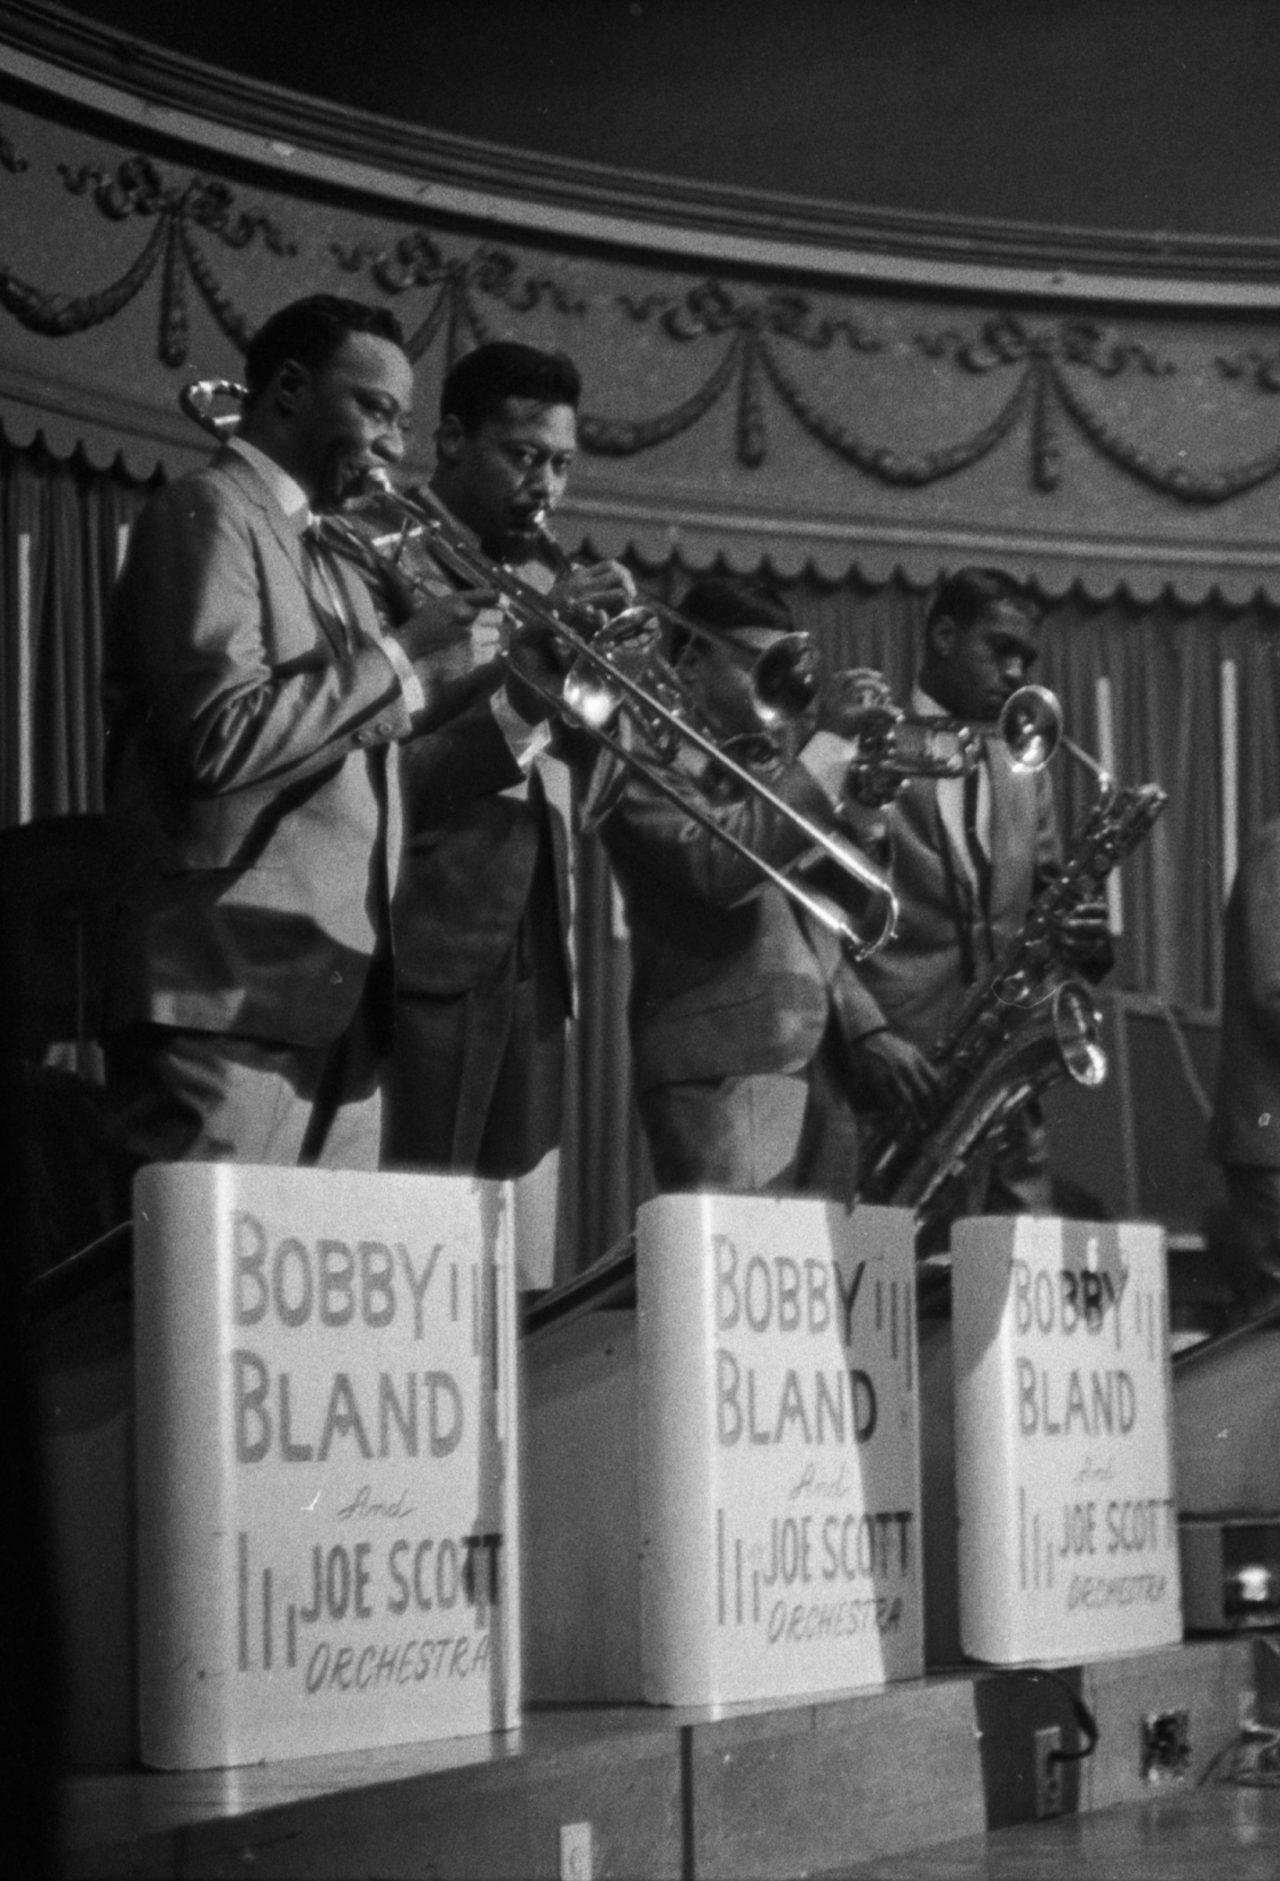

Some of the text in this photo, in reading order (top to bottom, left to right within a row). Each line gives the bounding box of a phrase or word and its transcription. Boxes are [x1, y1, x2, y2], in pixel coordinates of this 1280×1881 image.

[231, 1211, 443, 1341] BOBBY
[713, 1233, 867, 1348] BOBBY
[1014, 1259, 1128, 1351] BOBBY
[231, 1349, 463, 1463] BLAND
[714, 1348, 878, 1448] BLAND
[1016, 1355, 1137, 1437] BLAND
[337, 1484, 418, 1521] And
[1060, 1501, 1096, 1557] JOE
[302, 1533, 502, 1623] JOE SCOTT
[762, 1511, 912, 1586] JOE SCOTT
[306, 1634, 490, 1693] ORCHESTRA
[768, 1598, 902, 1644] ORCHESTRA
